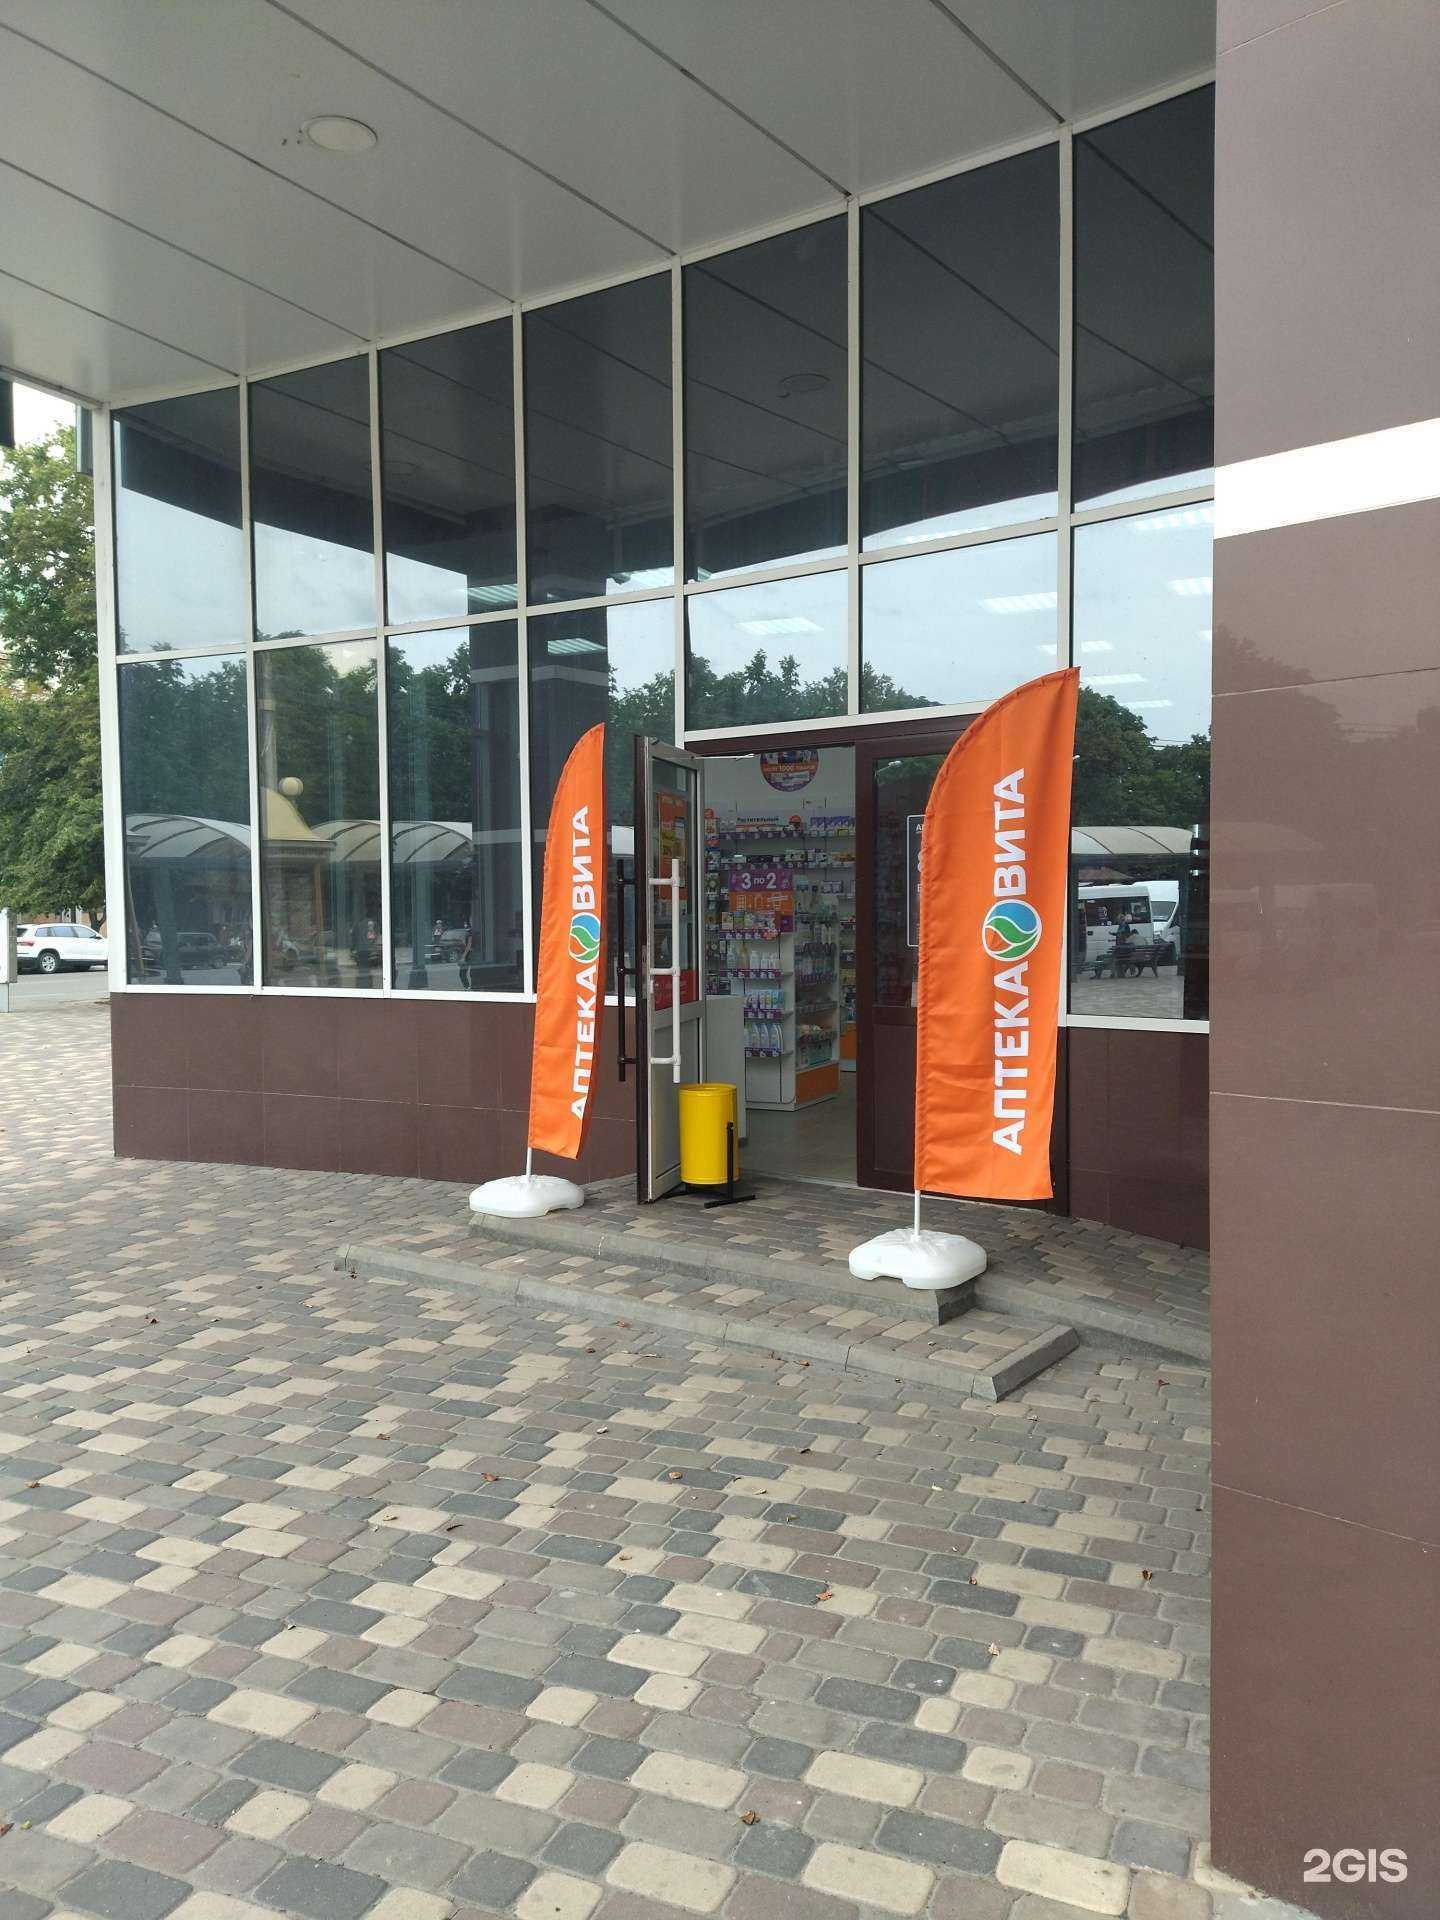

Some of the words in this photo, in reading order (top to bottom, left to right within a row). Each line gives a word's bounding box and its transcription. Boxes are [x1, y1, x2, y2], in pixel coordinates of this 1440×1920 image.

[571, 805, 594, 911] ВИТА
[741, 872, 752, 890] 3
[766, 872, 777, 889] 2
[993, 767, 1026, 897] ВИТА
[570, 963, 598, 1121] АПТЕКА
[992, 960, 1030, 1156] АПТЕКА
